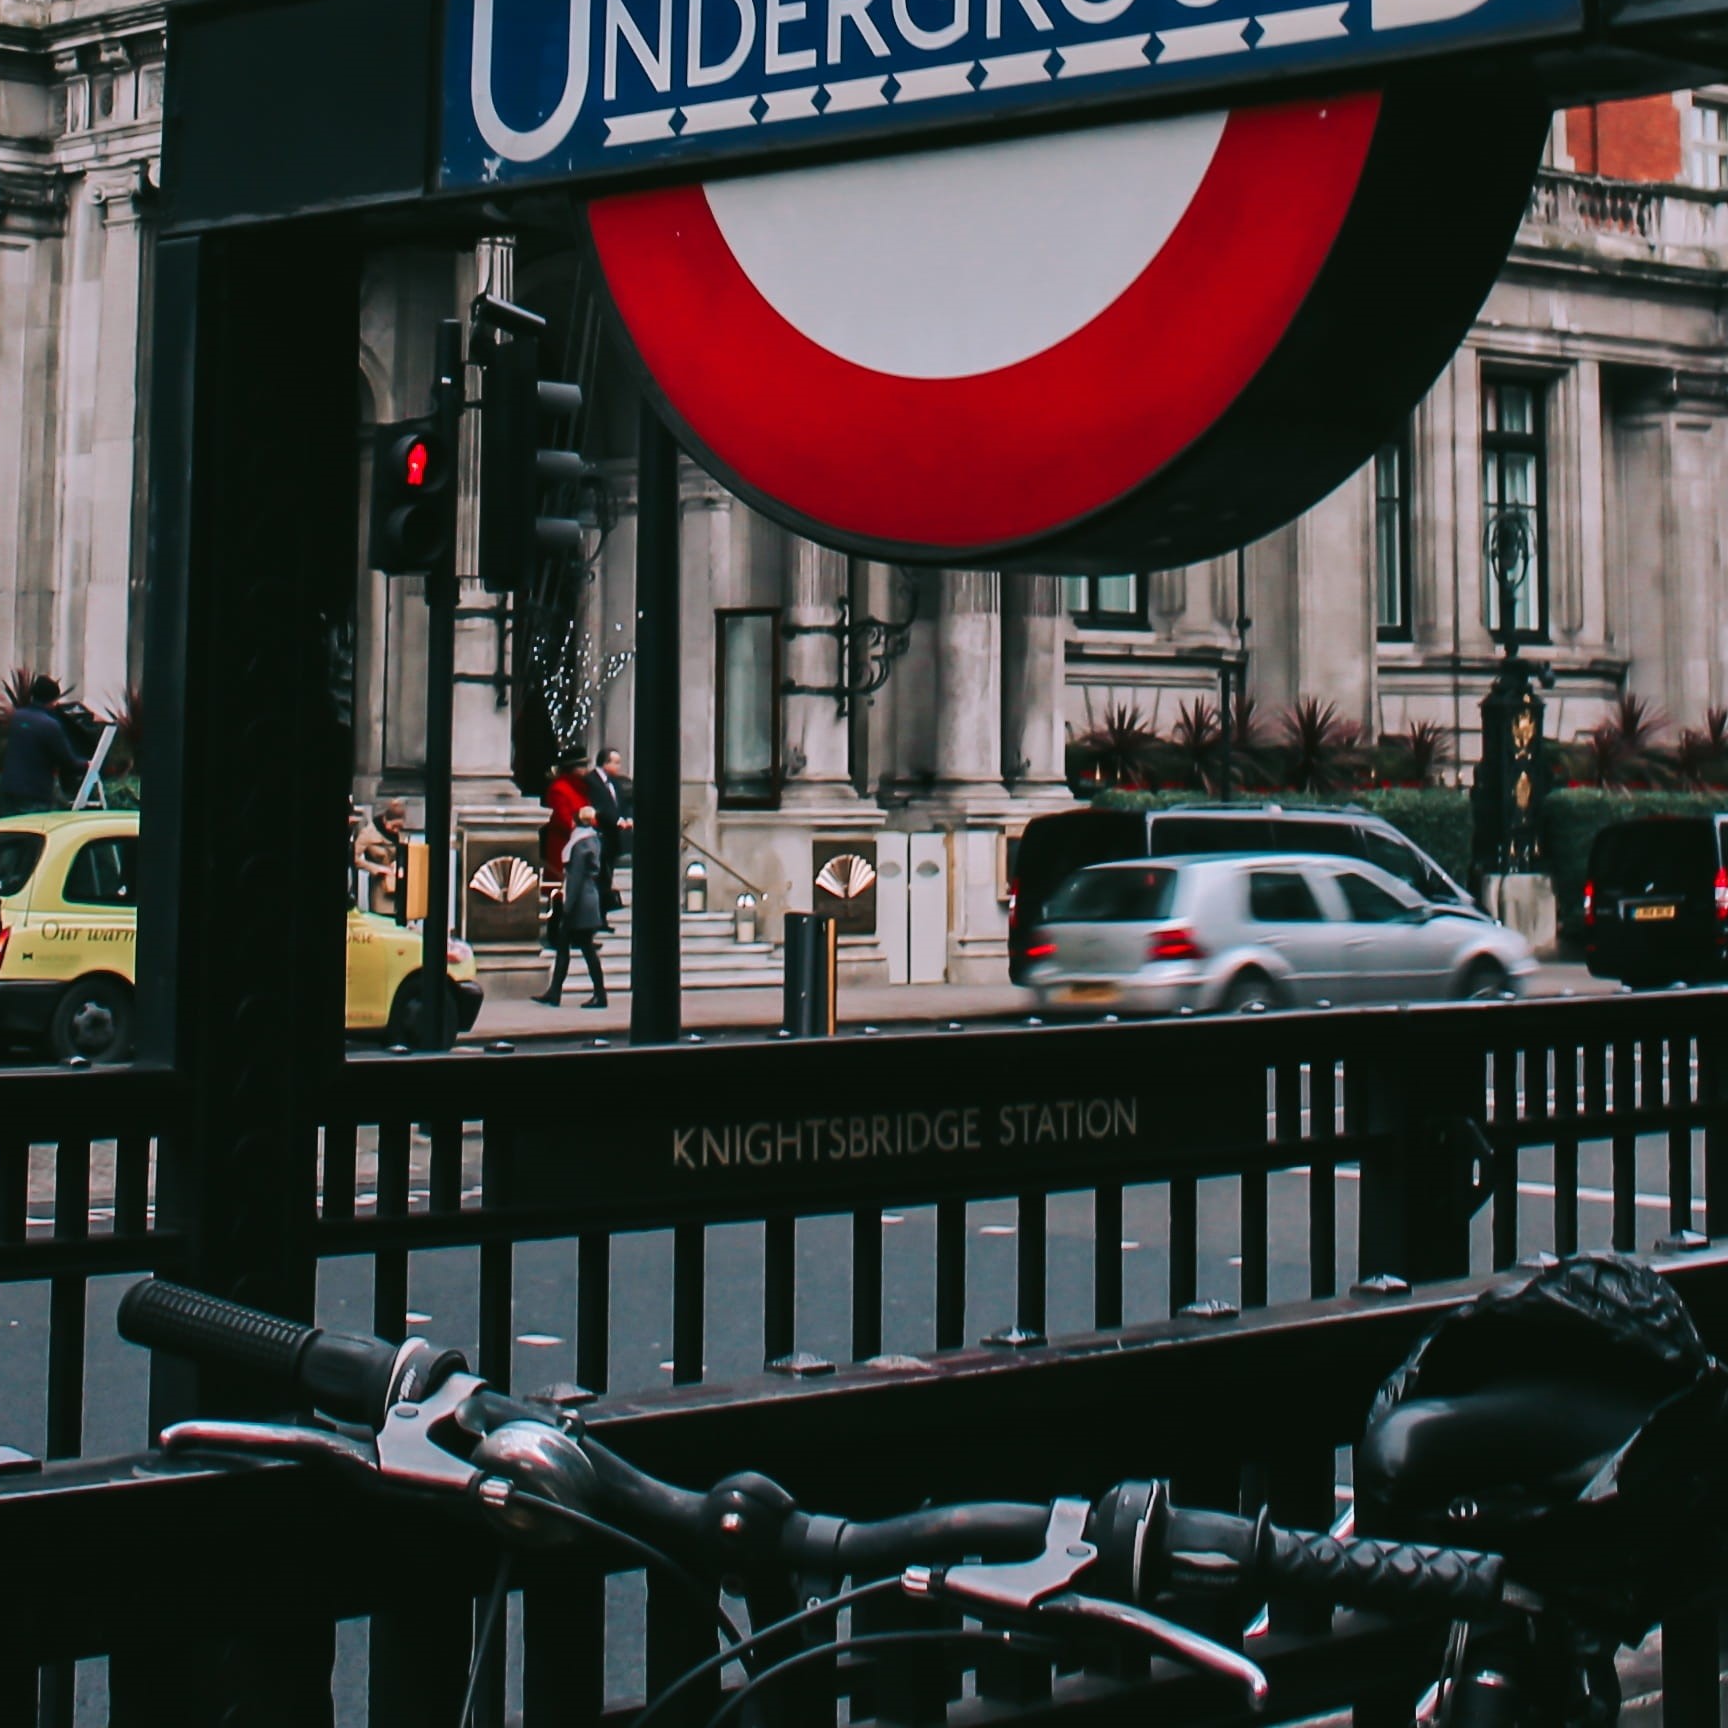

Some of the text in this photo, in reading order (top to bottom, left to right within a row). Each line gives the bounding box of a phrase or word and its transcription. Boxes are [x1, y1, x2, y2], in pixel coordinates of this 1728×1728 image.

[41, 919, 82, 941] Our
[672, 1096, 1138, 1169] KNIGHTSBRIDGE STATION
